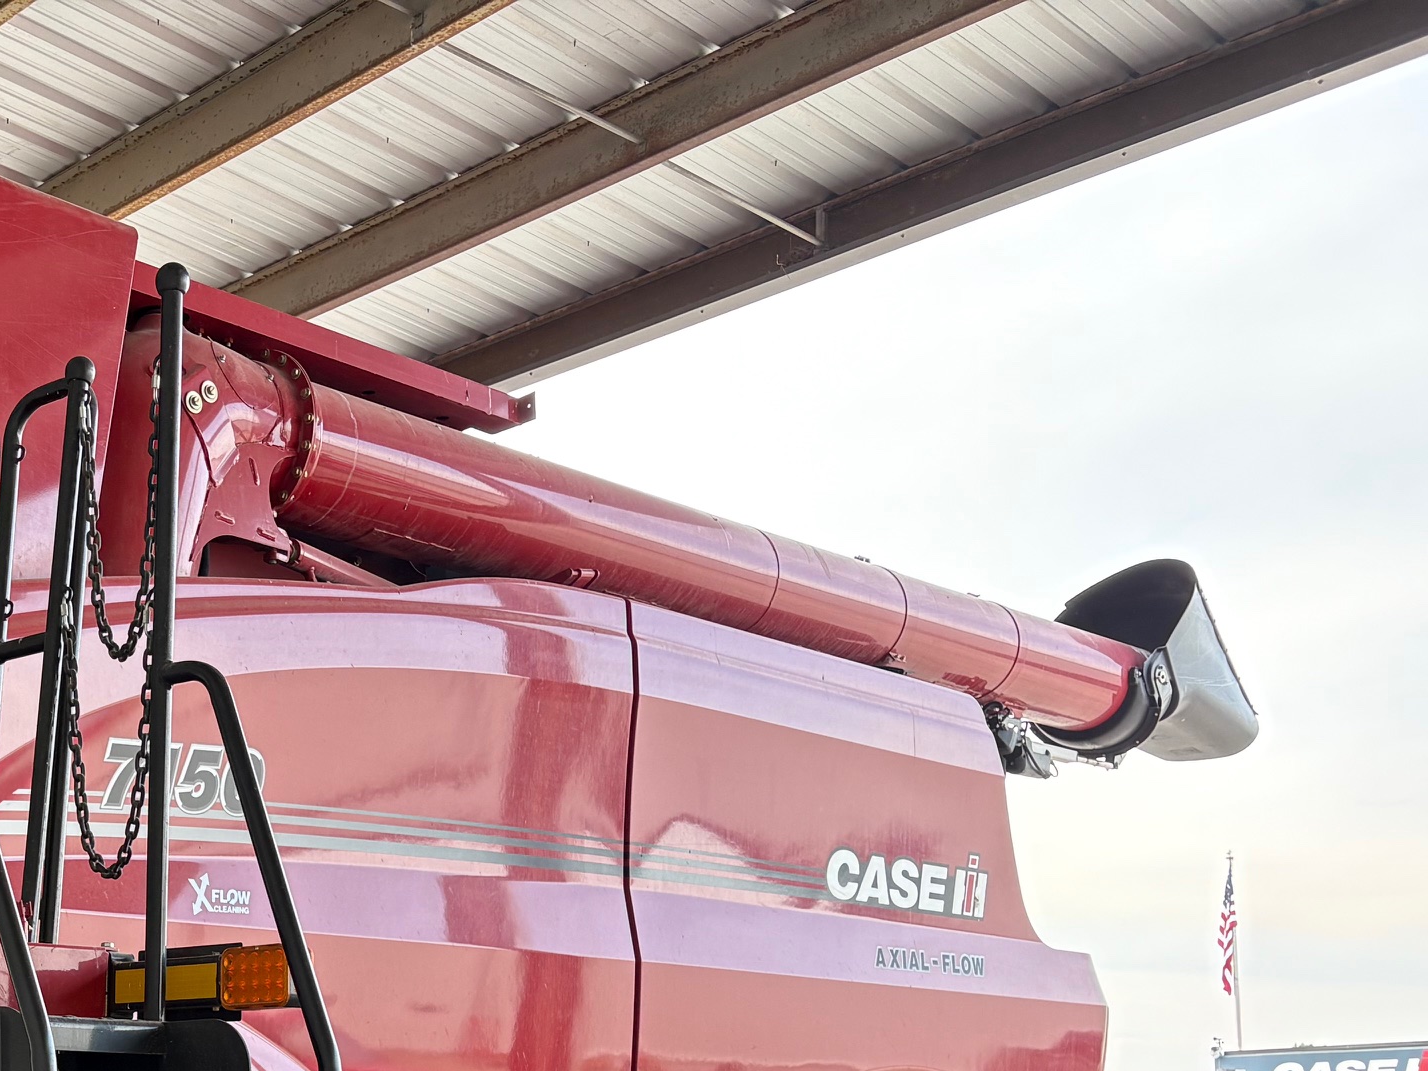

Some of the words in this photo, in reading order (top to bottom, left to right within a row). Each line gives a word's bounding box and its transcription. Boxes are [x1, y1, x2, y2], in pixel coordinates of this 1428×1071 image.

[826, 849, 948, 913] CASE
[211, 888, 251, 905] FLOW
[213, 905, 250, 915] CLEANING
[874, 945, 985, 977] AXIAL-FLOW
